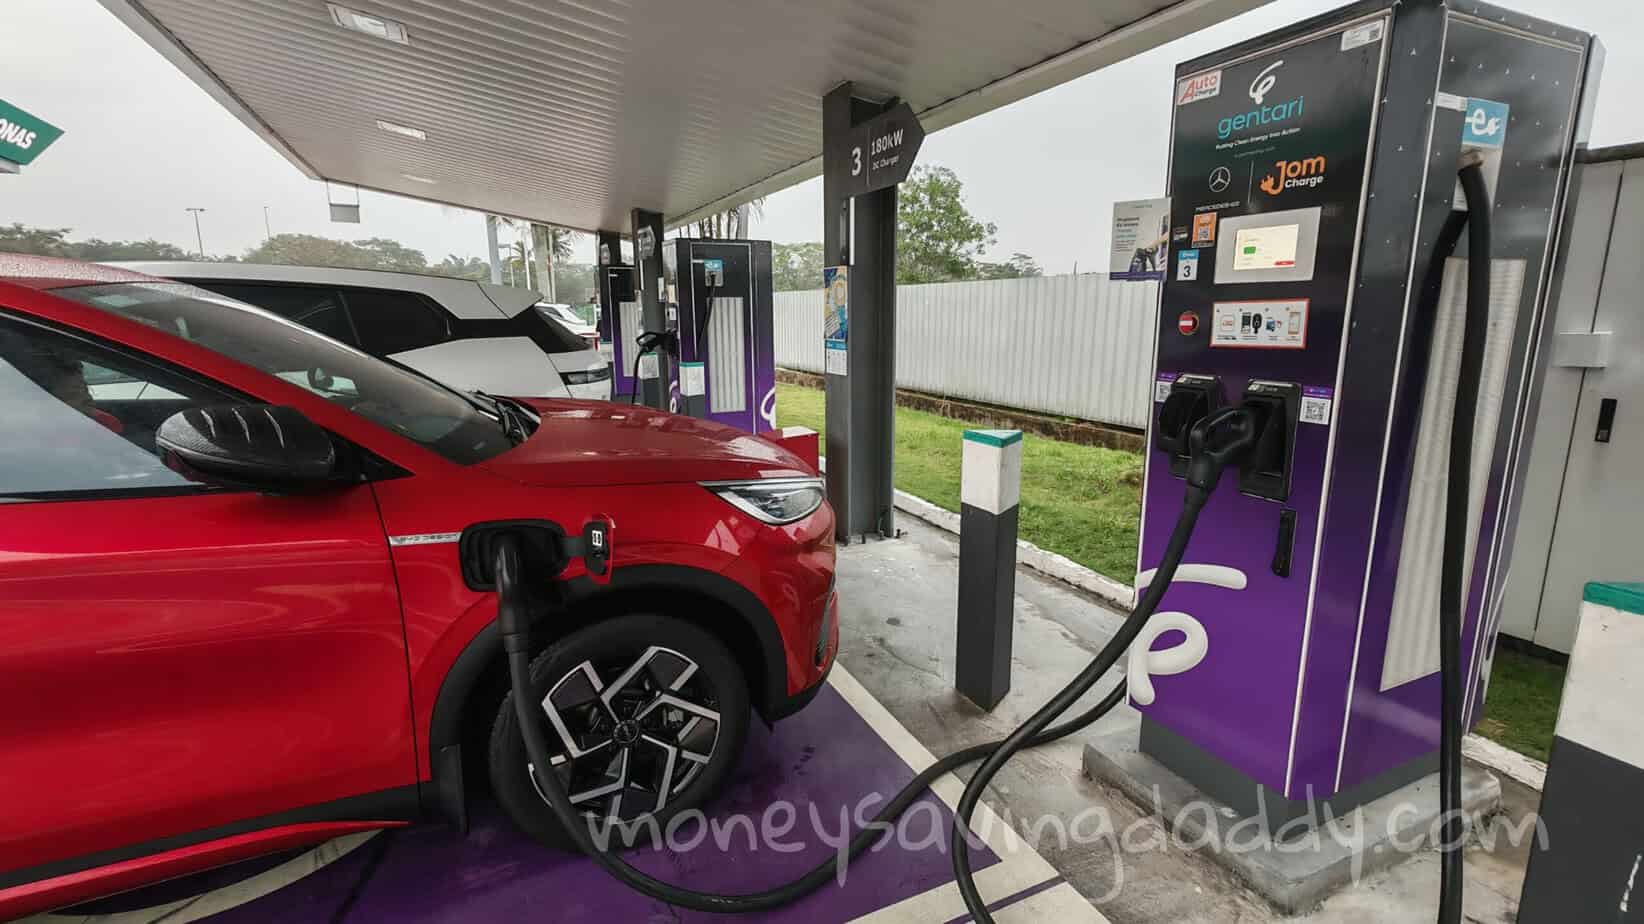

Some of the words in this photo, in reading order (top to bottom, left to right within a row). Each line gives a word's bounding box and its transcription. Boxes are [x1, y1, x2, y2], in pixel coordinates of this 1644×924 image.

[1180, 75, 1217, 103] Auto
[1218, 96, 1304, 139] gentari
[871, 128, 904, 156] 180kW
[851, 146, 861, 177] 3
[1261, 154, 1327, 196] Jom
[1284, 175, 1325, 189] Charge
[1183, 264, 1192, 278] 3
